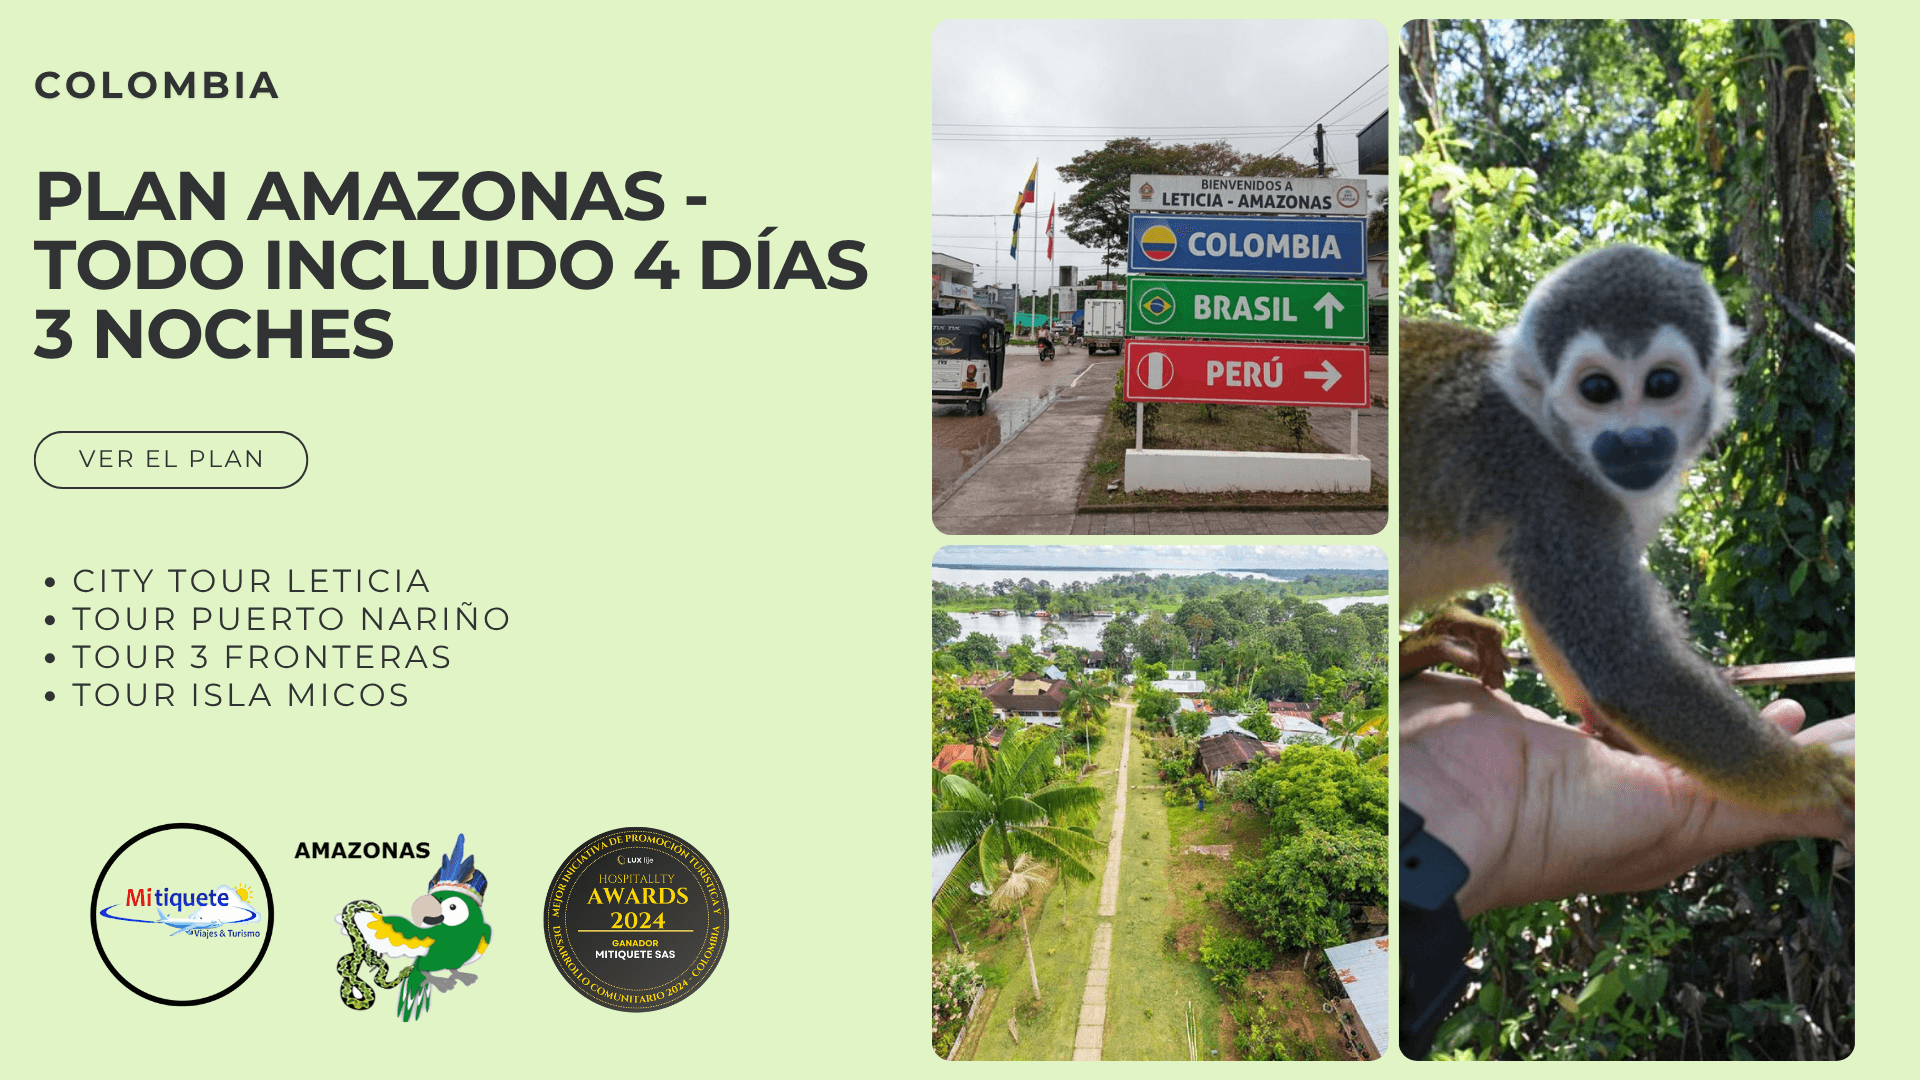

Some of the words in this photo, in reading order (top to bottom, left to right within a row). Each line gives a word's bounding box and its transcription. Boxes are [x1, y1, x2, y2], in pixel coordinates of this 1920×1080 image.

[1201, 179, 1282, 192] BIENVENIDOS
[1284, 180, 1293, 192] A
[1162, 192, 1223, 208] LETICIA
[1237, 194, 1332, 211] AMAZONAS
[1188, 231, 1342, 260] COLOMBIA
[1193, 294, 1298, 322] BRASIL
[1206, 355, 1284, 388] PERÚ
